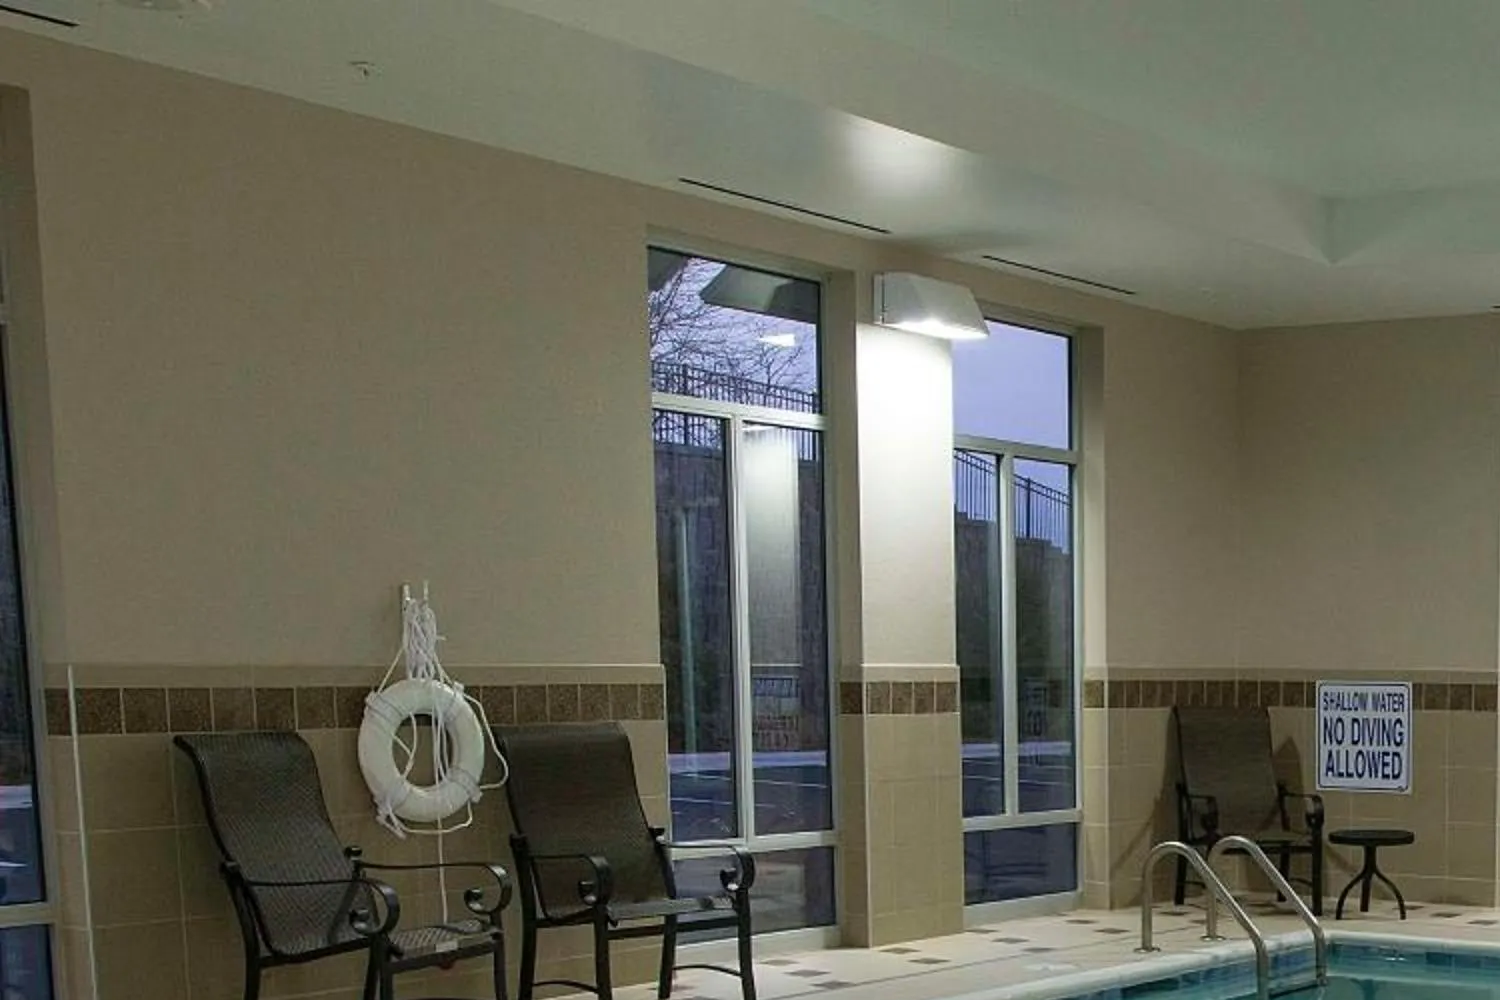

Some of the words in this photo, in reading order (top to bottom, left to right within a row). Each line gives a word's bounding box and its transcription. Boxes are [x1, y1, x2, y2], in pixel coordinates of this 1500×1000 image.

[1323, 692, 1368, 711] SHALLOW
[1372, 692, 1405, 712] WATER
[1323, 717, 1345, 745] NO
[1351, 718, 1404, 746] DIVING
[1325, 749, 1402, 779] ALLOWED
